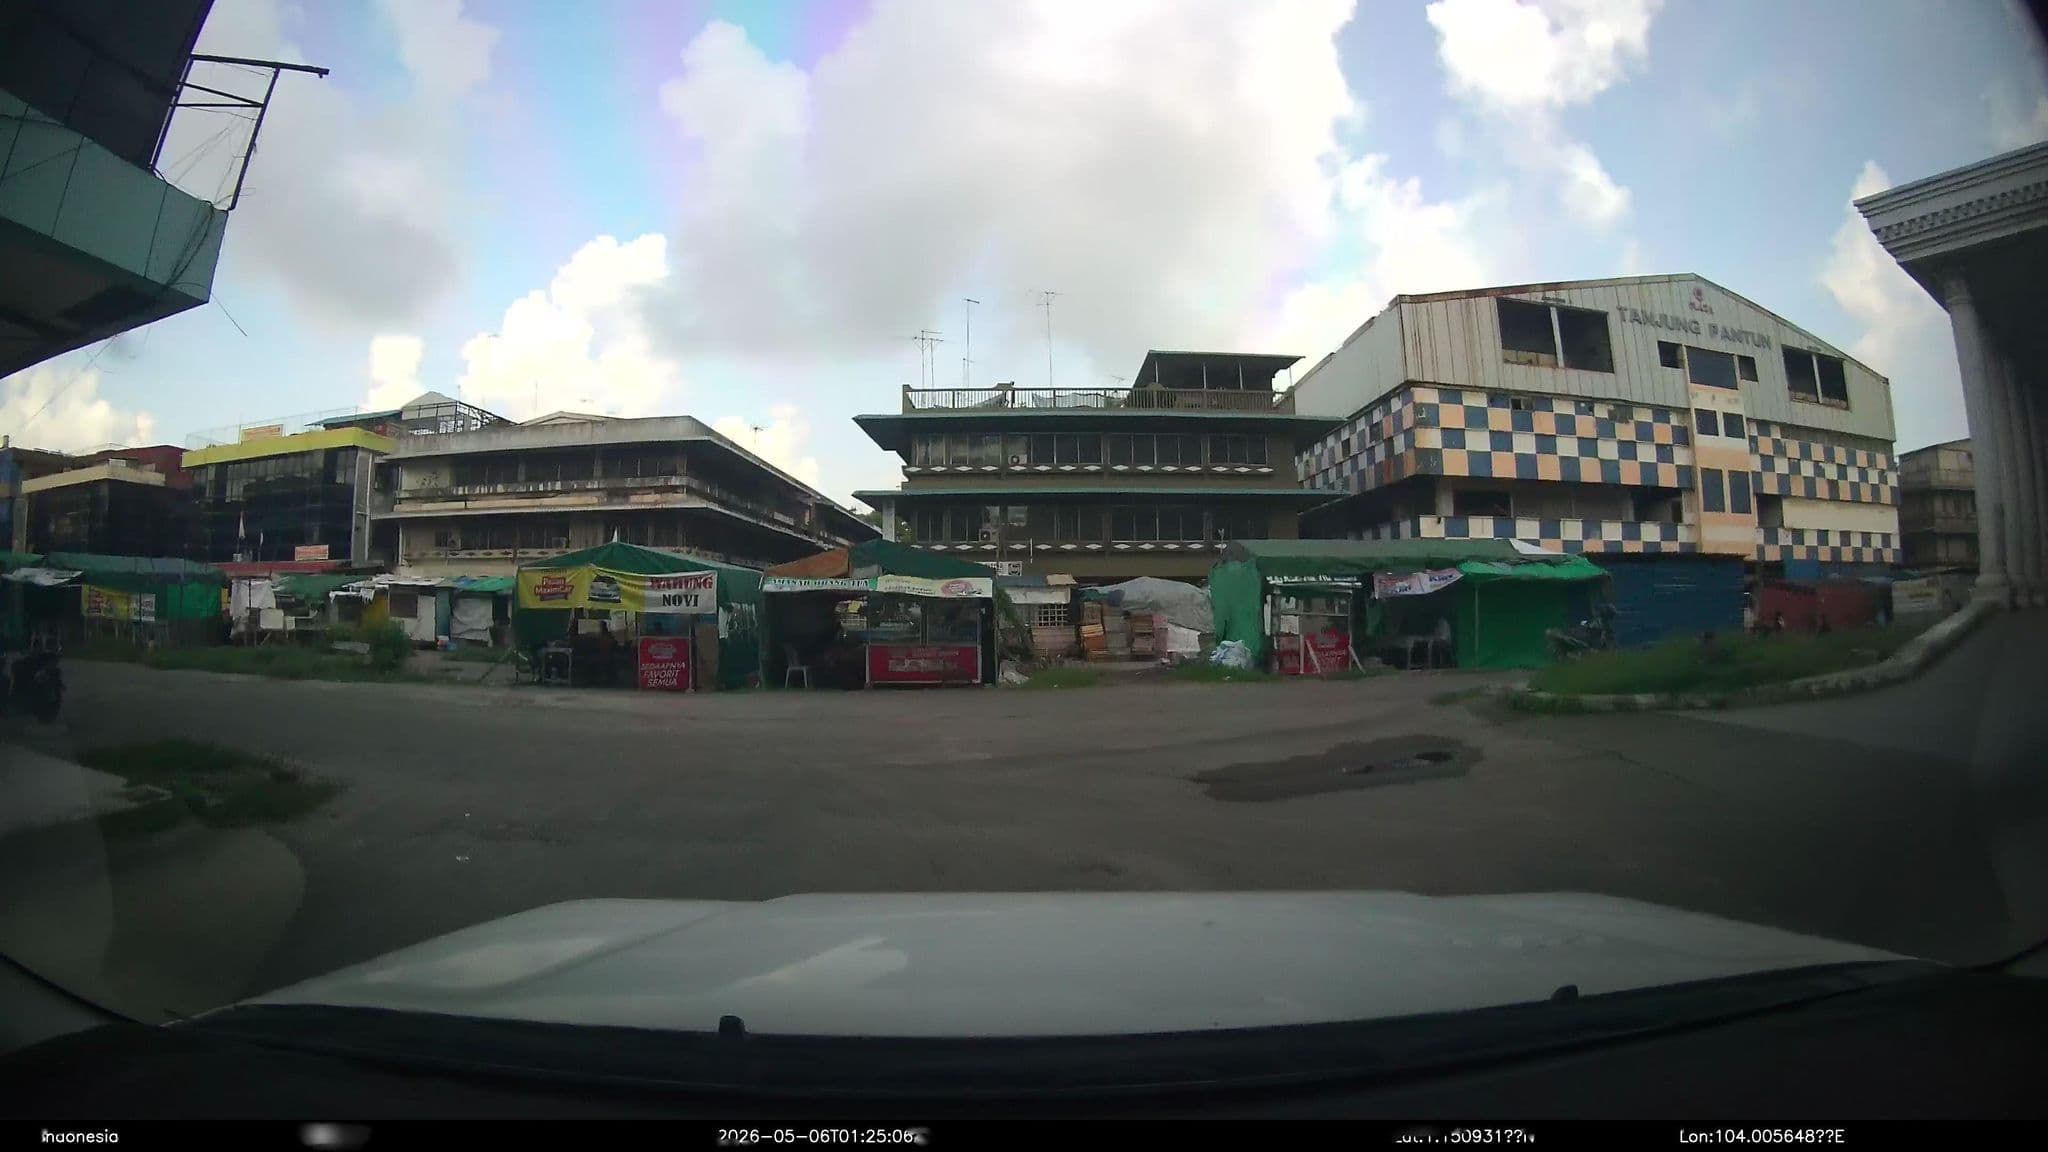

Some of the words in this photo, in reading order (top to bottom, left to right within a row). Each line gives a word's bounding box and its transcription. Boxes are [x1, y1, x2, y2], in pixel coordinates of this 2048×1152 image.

[1617, 305, 1701, 335] TANJUNG
[1708, 323, 1771, 349] PANTUN
[662, 593, 699, 608] NOVI
[643, 669, 681, 679] FAVORIT
[647, 678, 678, 688] SEMUA
